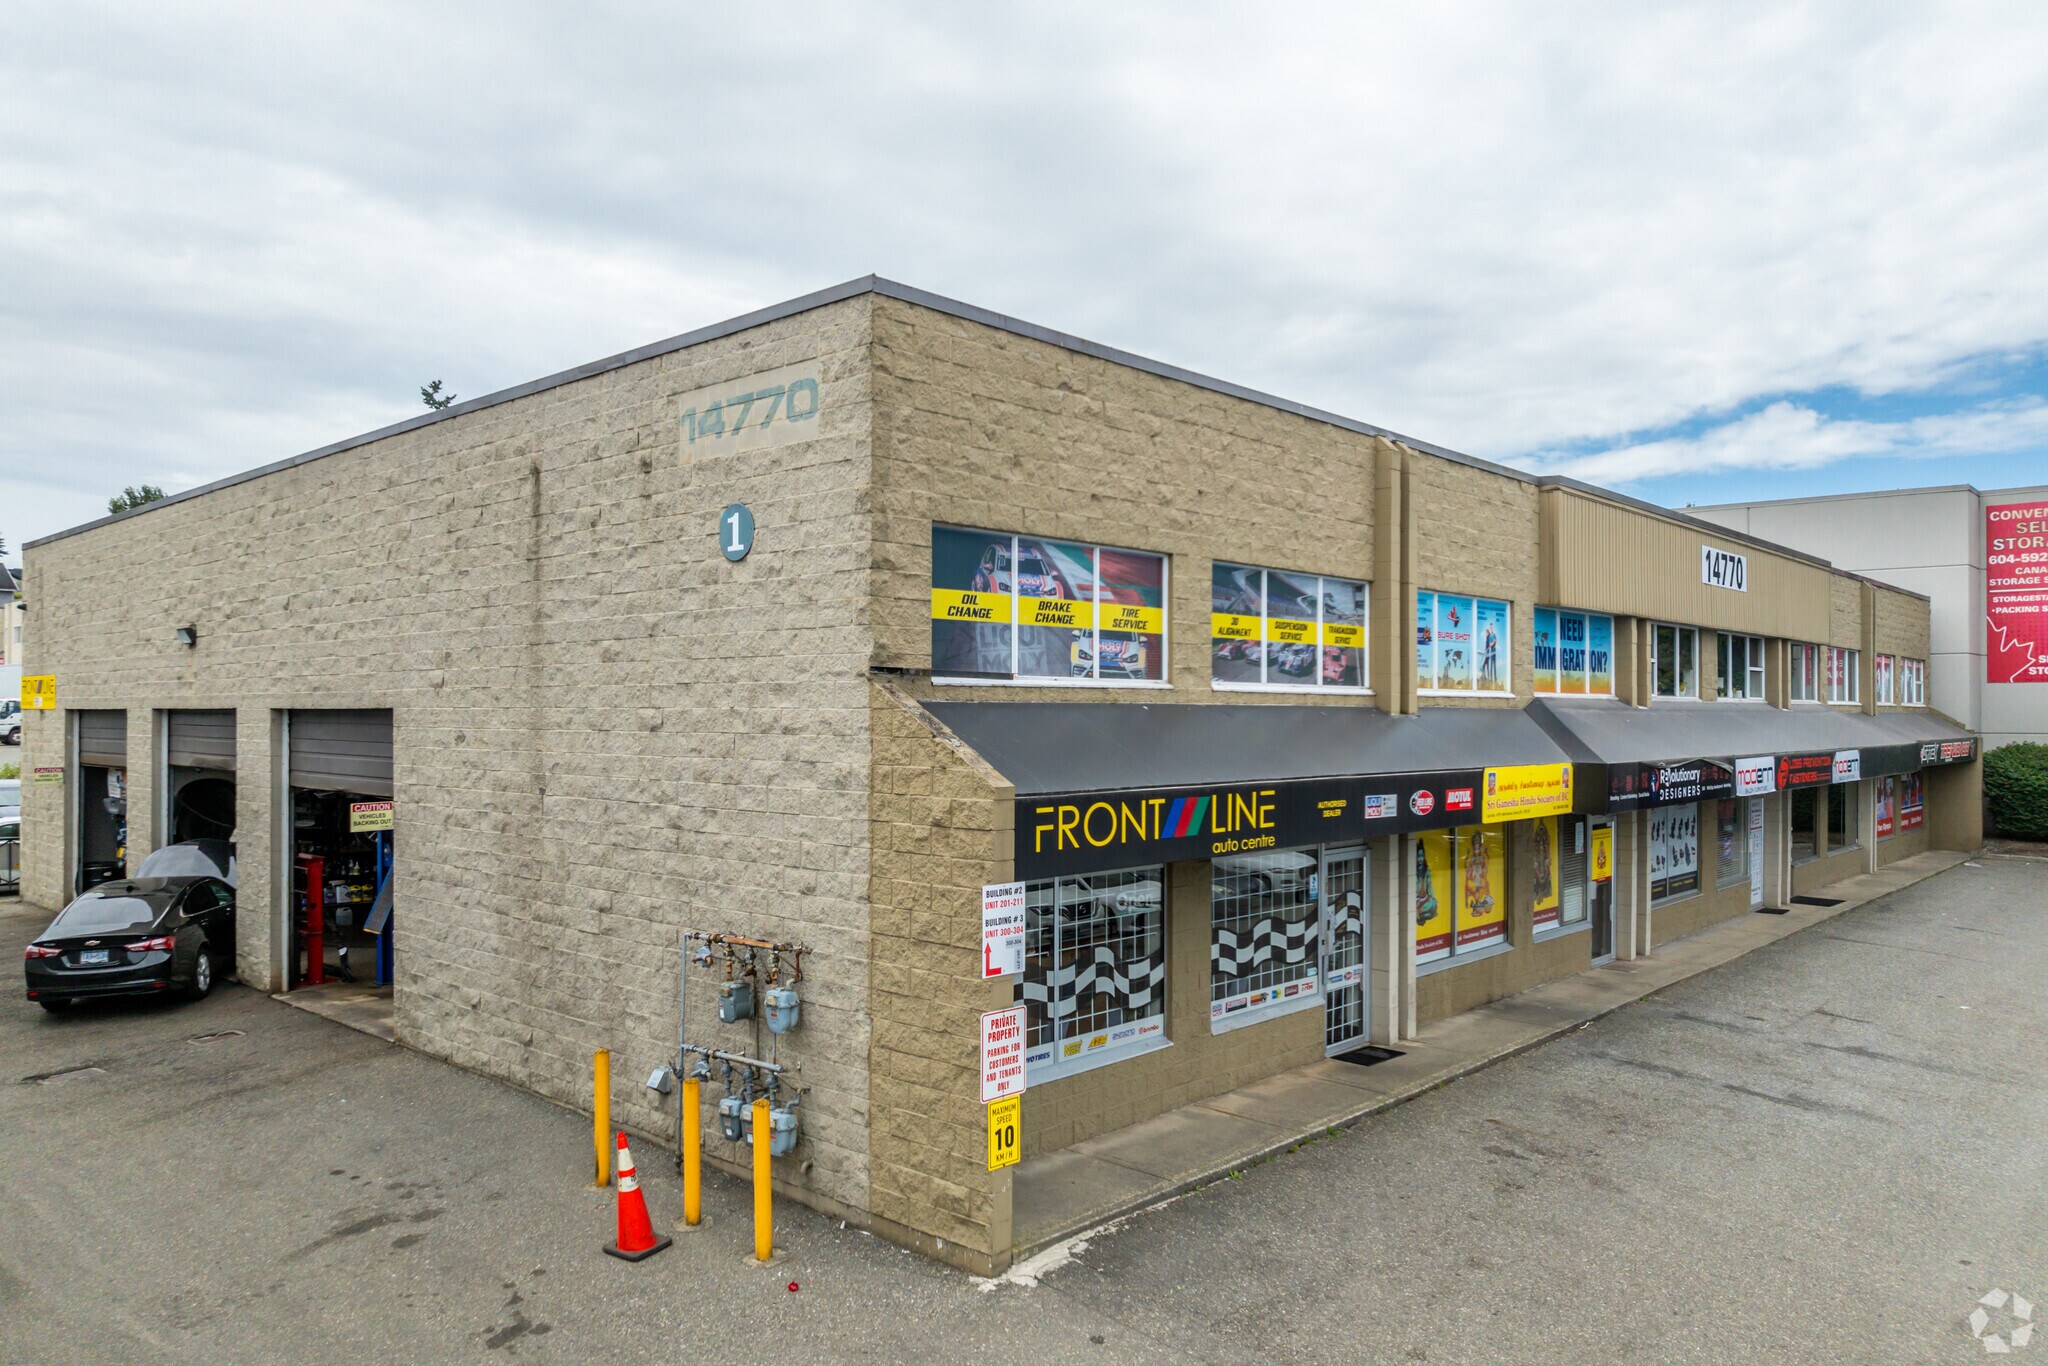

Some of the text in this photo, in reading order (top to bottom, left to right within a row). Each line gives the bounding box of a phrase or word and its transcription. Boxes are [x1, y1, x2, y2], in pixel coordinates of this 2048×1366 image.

[680, 377, 819, 444] 14770
[727, 512, 744, 552] 1
[2016, 521, 2048, 534] SEL
[1993, 536, 2048, 550] STOR
[1989, 552, 2048, 564] 604-592
[1706, 550, 1743, 589] 14770
[1990, 576, 2040, 586] STORAGE
[961, 594, 979, 605] OIL
[947, 606, 993, 619] CHANGE
[1038, 601, 1072, 612] BRAKE
[1035, 612, 1076, 625] CHANGE
[1121, 608, 1140, 618] TIRE
[1112, 618, 1148, 630] SERVICE
[1274, 621, 1308, 631] SUSPENSION
[1560, 617, 1584, 642] NEED
[1218, 626, 1252, 637] ALIGNMENT
[1280, 632, 1303, 641] SERVICE
[1328, 626, 1357, 635] TRANSMISSION
[1437, 631, 1453, 640] SURE
[1455, 632, 1471, 641] SHOT
[1334, 636, 1351, 644] SERVICE
[2039, 655, 2048, 663] S
[1447, 791, 1471, 803] MOTUL
[1660, 785, 1701, 800] DESIGNERS
[1318, 799, 1347, 808] AUTHORISED
[1487, 791, 1569, 810] Sri Ganesha Hindu Society of BC
[354, 803, 391, 812] CAUTION
[1323, 809, 1341, 817] DEALER
[1036, 790, 1275, 852] FRONT LINE
[1213, 834, 1275, 854] auto centre
[986, 887, 1022, 898] BUILDING #2
[985, 898, 1023, 910] UNIT 201-211
[985, 916, 1011, 927] BUILDING
[1020, 914, 1023, 922] 3
[985, 926, 1023, 938] UNIT 300-304
[1006, 938, 1021, 946] 300-304
[990, 1014, 1017, 1030] PRIVATE
[987, 1026, 1020, 1043] PROPERTY
[987, 1042, 1021, 1058] PARKING FOR
[989, 1055, 1019, 1070] CUSTOMERS
[1035, 1052, 1050, 1062] TIRES
[986, 1065, 1021, 1082] AND TENANTS
[997, 1081, 1009, 1092] ONLY
[992, 1103, 1016, 1116] MAXIMUM
[996, 1115, 1012, 1125] SPEED
[995, 1125, 1014, 1151] 10
[996, 1152, 1005, 1162] KM
